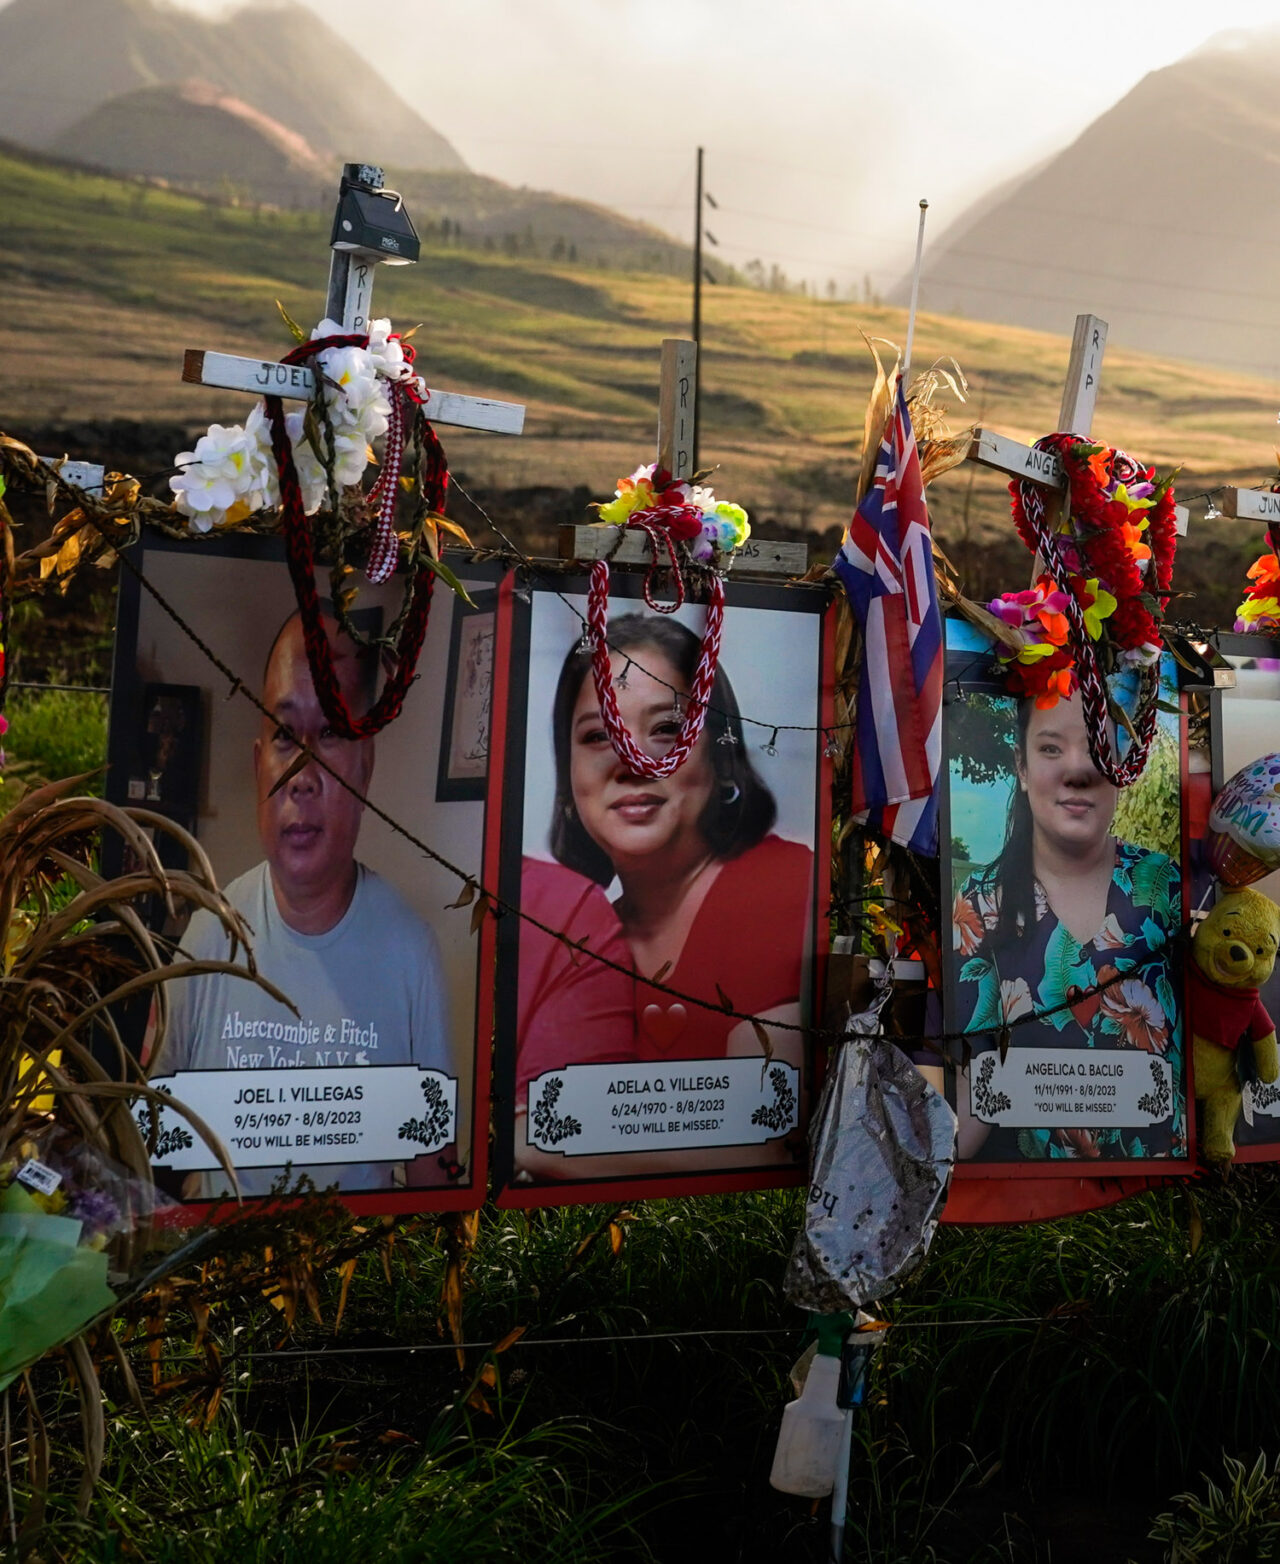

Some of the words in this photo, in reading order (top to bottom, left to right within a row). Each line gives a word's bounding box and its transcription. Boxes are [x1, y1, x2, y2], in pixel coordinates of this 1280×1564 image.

[354, 264, 368, 330] RIP
[1085, 329, 1099, 390] RIP
[256, 362, 313, 388] JOEL
[678, 377, 689, 478] RIP
[1025, 451, 1058, 477] ANGE
[221, 1012, 319, 1045] Abercrombie
[324, 1024, 337, 1044] &
[340, 1018, 379, 1049] Fitch
[226, 1046, 264, 1069] New
[268, 1045, 306, 1067] York
[1025, 1063, 1075, 1077] ANGELICA
[1089, 1064, 1124, 1078] BACLIG
[234, 1089, 275, 1104] JOEL
[278, 1088, 286, 1104] I.
[290, 1085, 364, 1103] VILLEGAS
[606, 1079, 651, 1095] ADELA
[669, 1075, 730, 1092] VILLEGAS
[1034, 1084, 1073, 1096] 11/11/1991
[1079, 1084, 1116, 1097] 8/8/2023
[611, 1101, 667, 1118] 6/24/1970
[676, 1098, 725, 1115] 8/8/2023
[1055, 1102, 1073, 1113] WILL
[1074, 1102, 1084, 1113] BE
[233, 1112, 292, 1130] 9/5/1967
[302, 1110, 361, 1127] 8/8/2023
[618, 1123, 640, 1136] YOU
[641, 1121, 666, 1134] WILL
[668, 1120, 681, 1133] BE
[264, 1135, 292, 1149] WILL
[296, 1134, 310, 1147] BE
